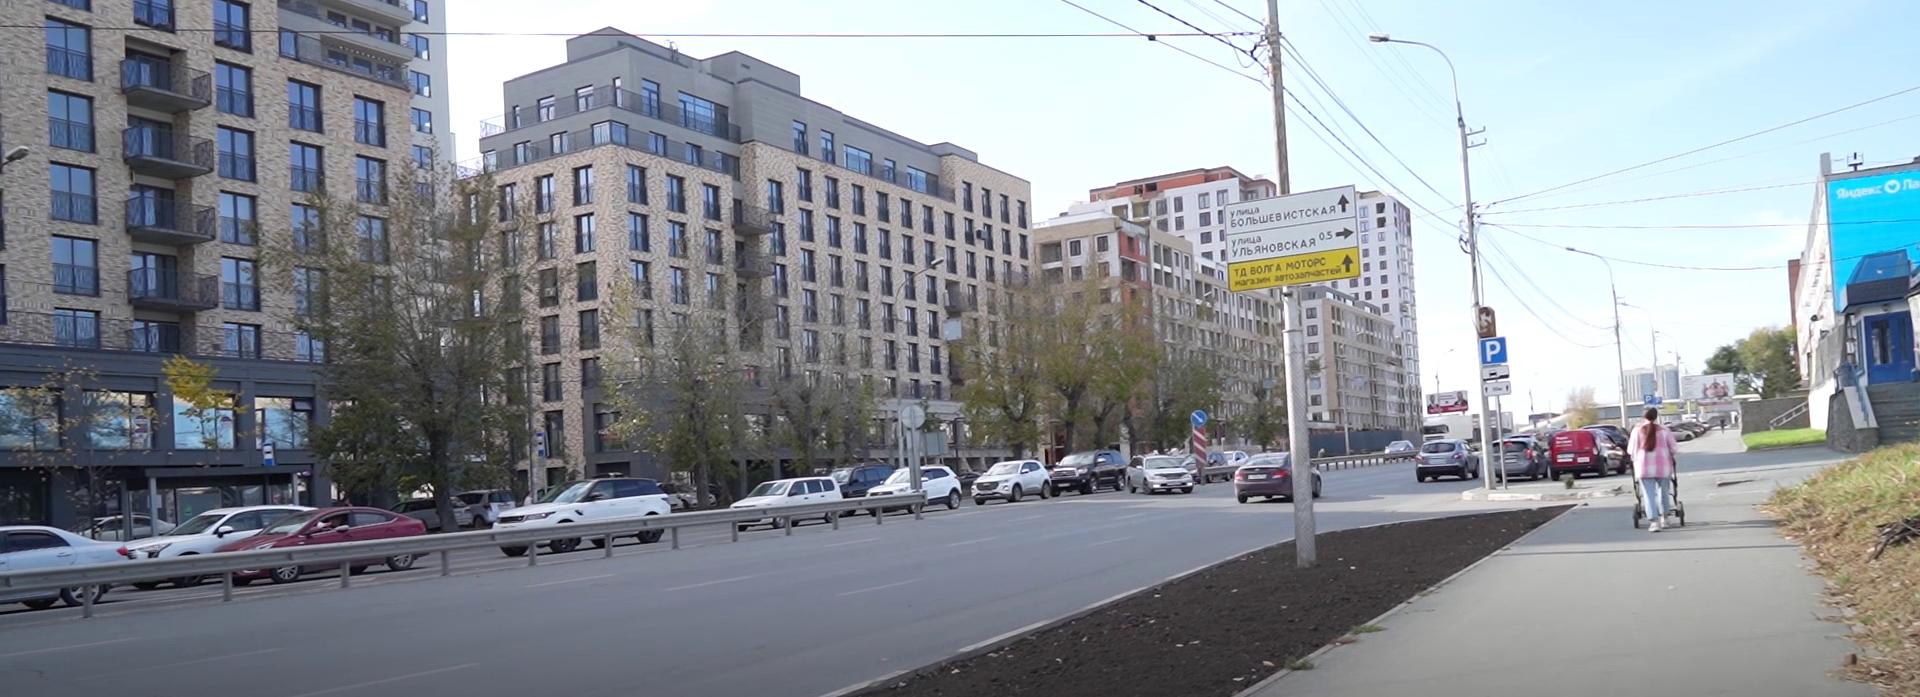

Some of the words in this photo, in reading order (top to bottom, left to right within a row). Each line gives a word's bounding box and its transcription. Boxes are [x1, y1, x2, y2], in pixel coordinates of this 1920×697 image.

[1230, 205, 1336, 228] БОЛЬШЕВИСТСКАЯ
[1231, 207, 1260, 218] улица
[1232, 235, 1262, 247] улица
[1232, 238, 1316, 257] УЛЬЯНОВСКАЯ
[1234, 267, 1247, 277] ТД
[1250, 263, 1282, 275] ВОЛГА
[1286, 257, 1326, 271] МОТОРС
[1234, 276, 1271, 287] магазин
[1275, 265, 1342, 281] автозапчастей
[1486, 340, 1501, 362] P
